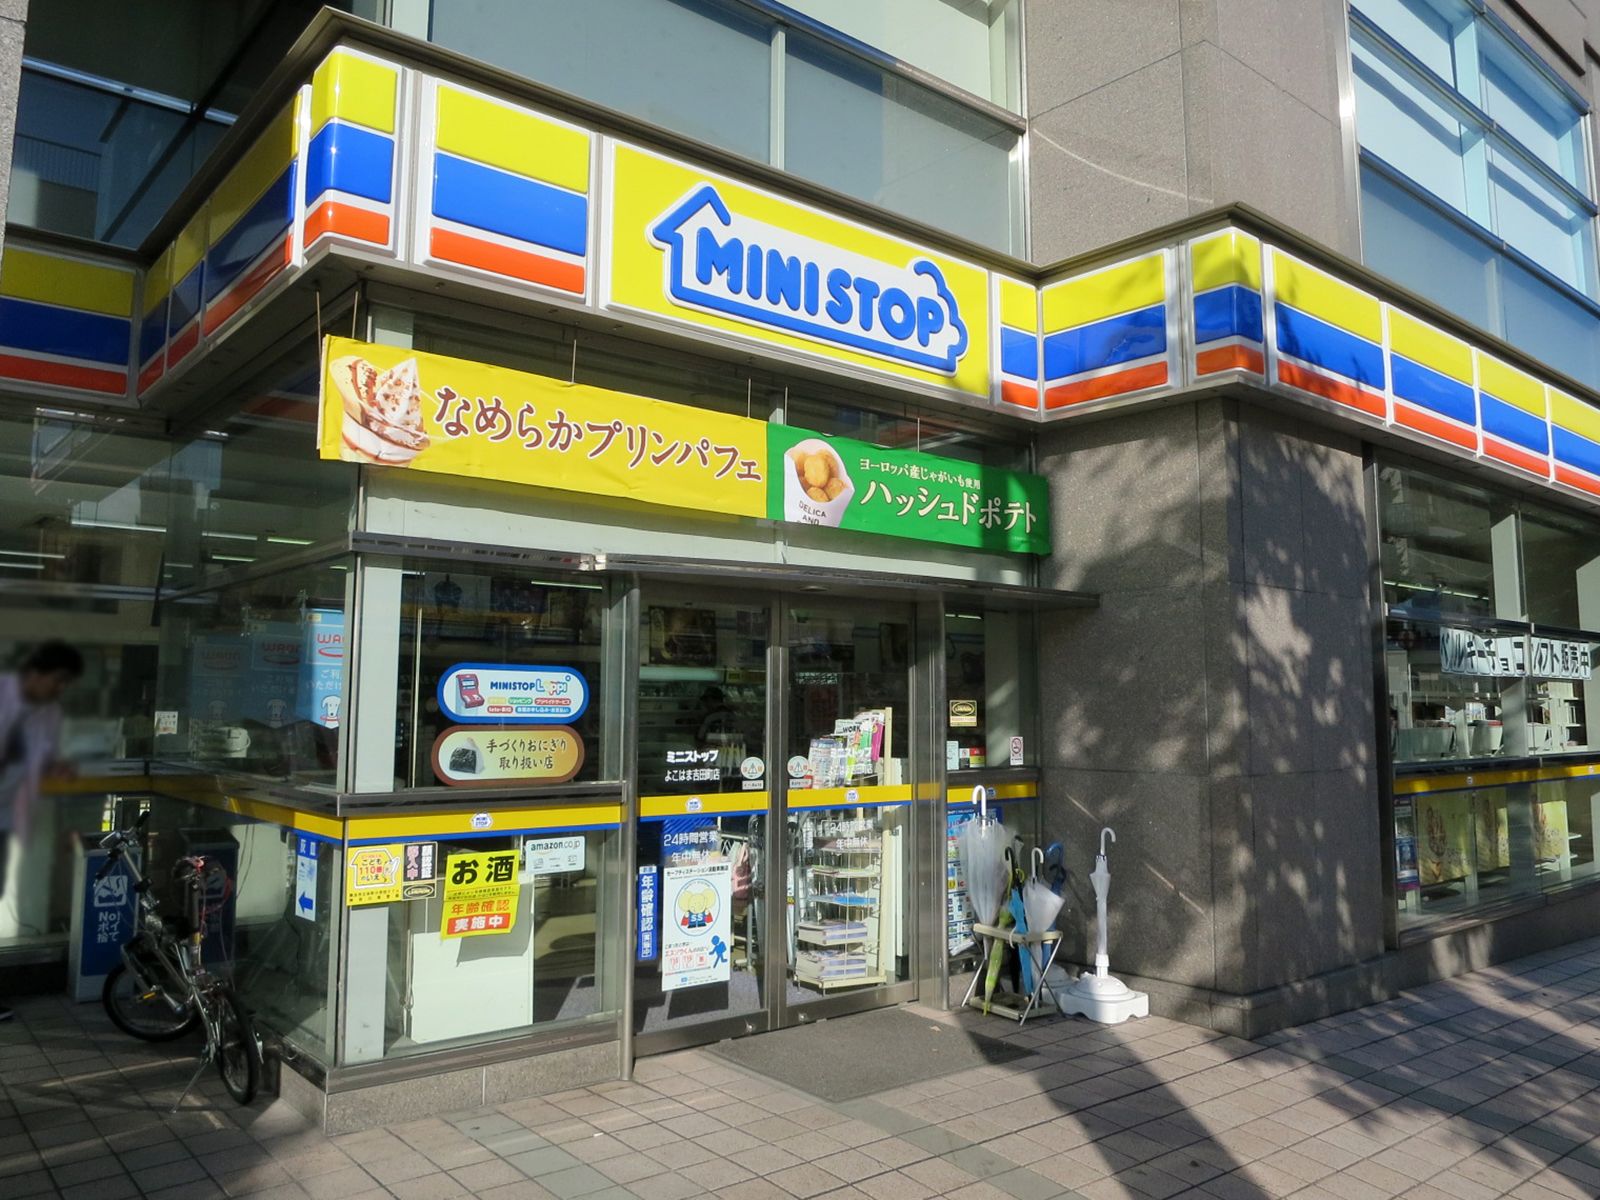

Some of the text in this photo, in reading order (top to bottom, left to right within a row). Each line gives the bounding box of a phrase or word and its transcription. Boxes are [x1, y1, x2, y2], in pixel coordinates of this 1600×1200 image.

[433, 385, 763, 482] なめらかプリンパフェ
[860, 458, 981, 490] ヨーロッパ産じゃがいも使用
[798, 500, 827, 518] DELICA
[860, 480, 1037, 534] ハッシュドポテト
[490, 675, 571, 696] MINISTOP Loppi
[486, 738, 567, 754] 手づくりおにぎり
[499, 756, 554, 770] 取り扱い店
[666, 749, 719, 763] ミニストップ
[664, 768, 720, 782] よこはま吉田町店
[663, 830, 718, 846] 24時間営業
[671, 849, 710, 862] 年中無休
[451, 855, 515, 885] お酒
[451, 899, 510, 915] 年齢確認
[454, 914, 503, 933] 実施中
